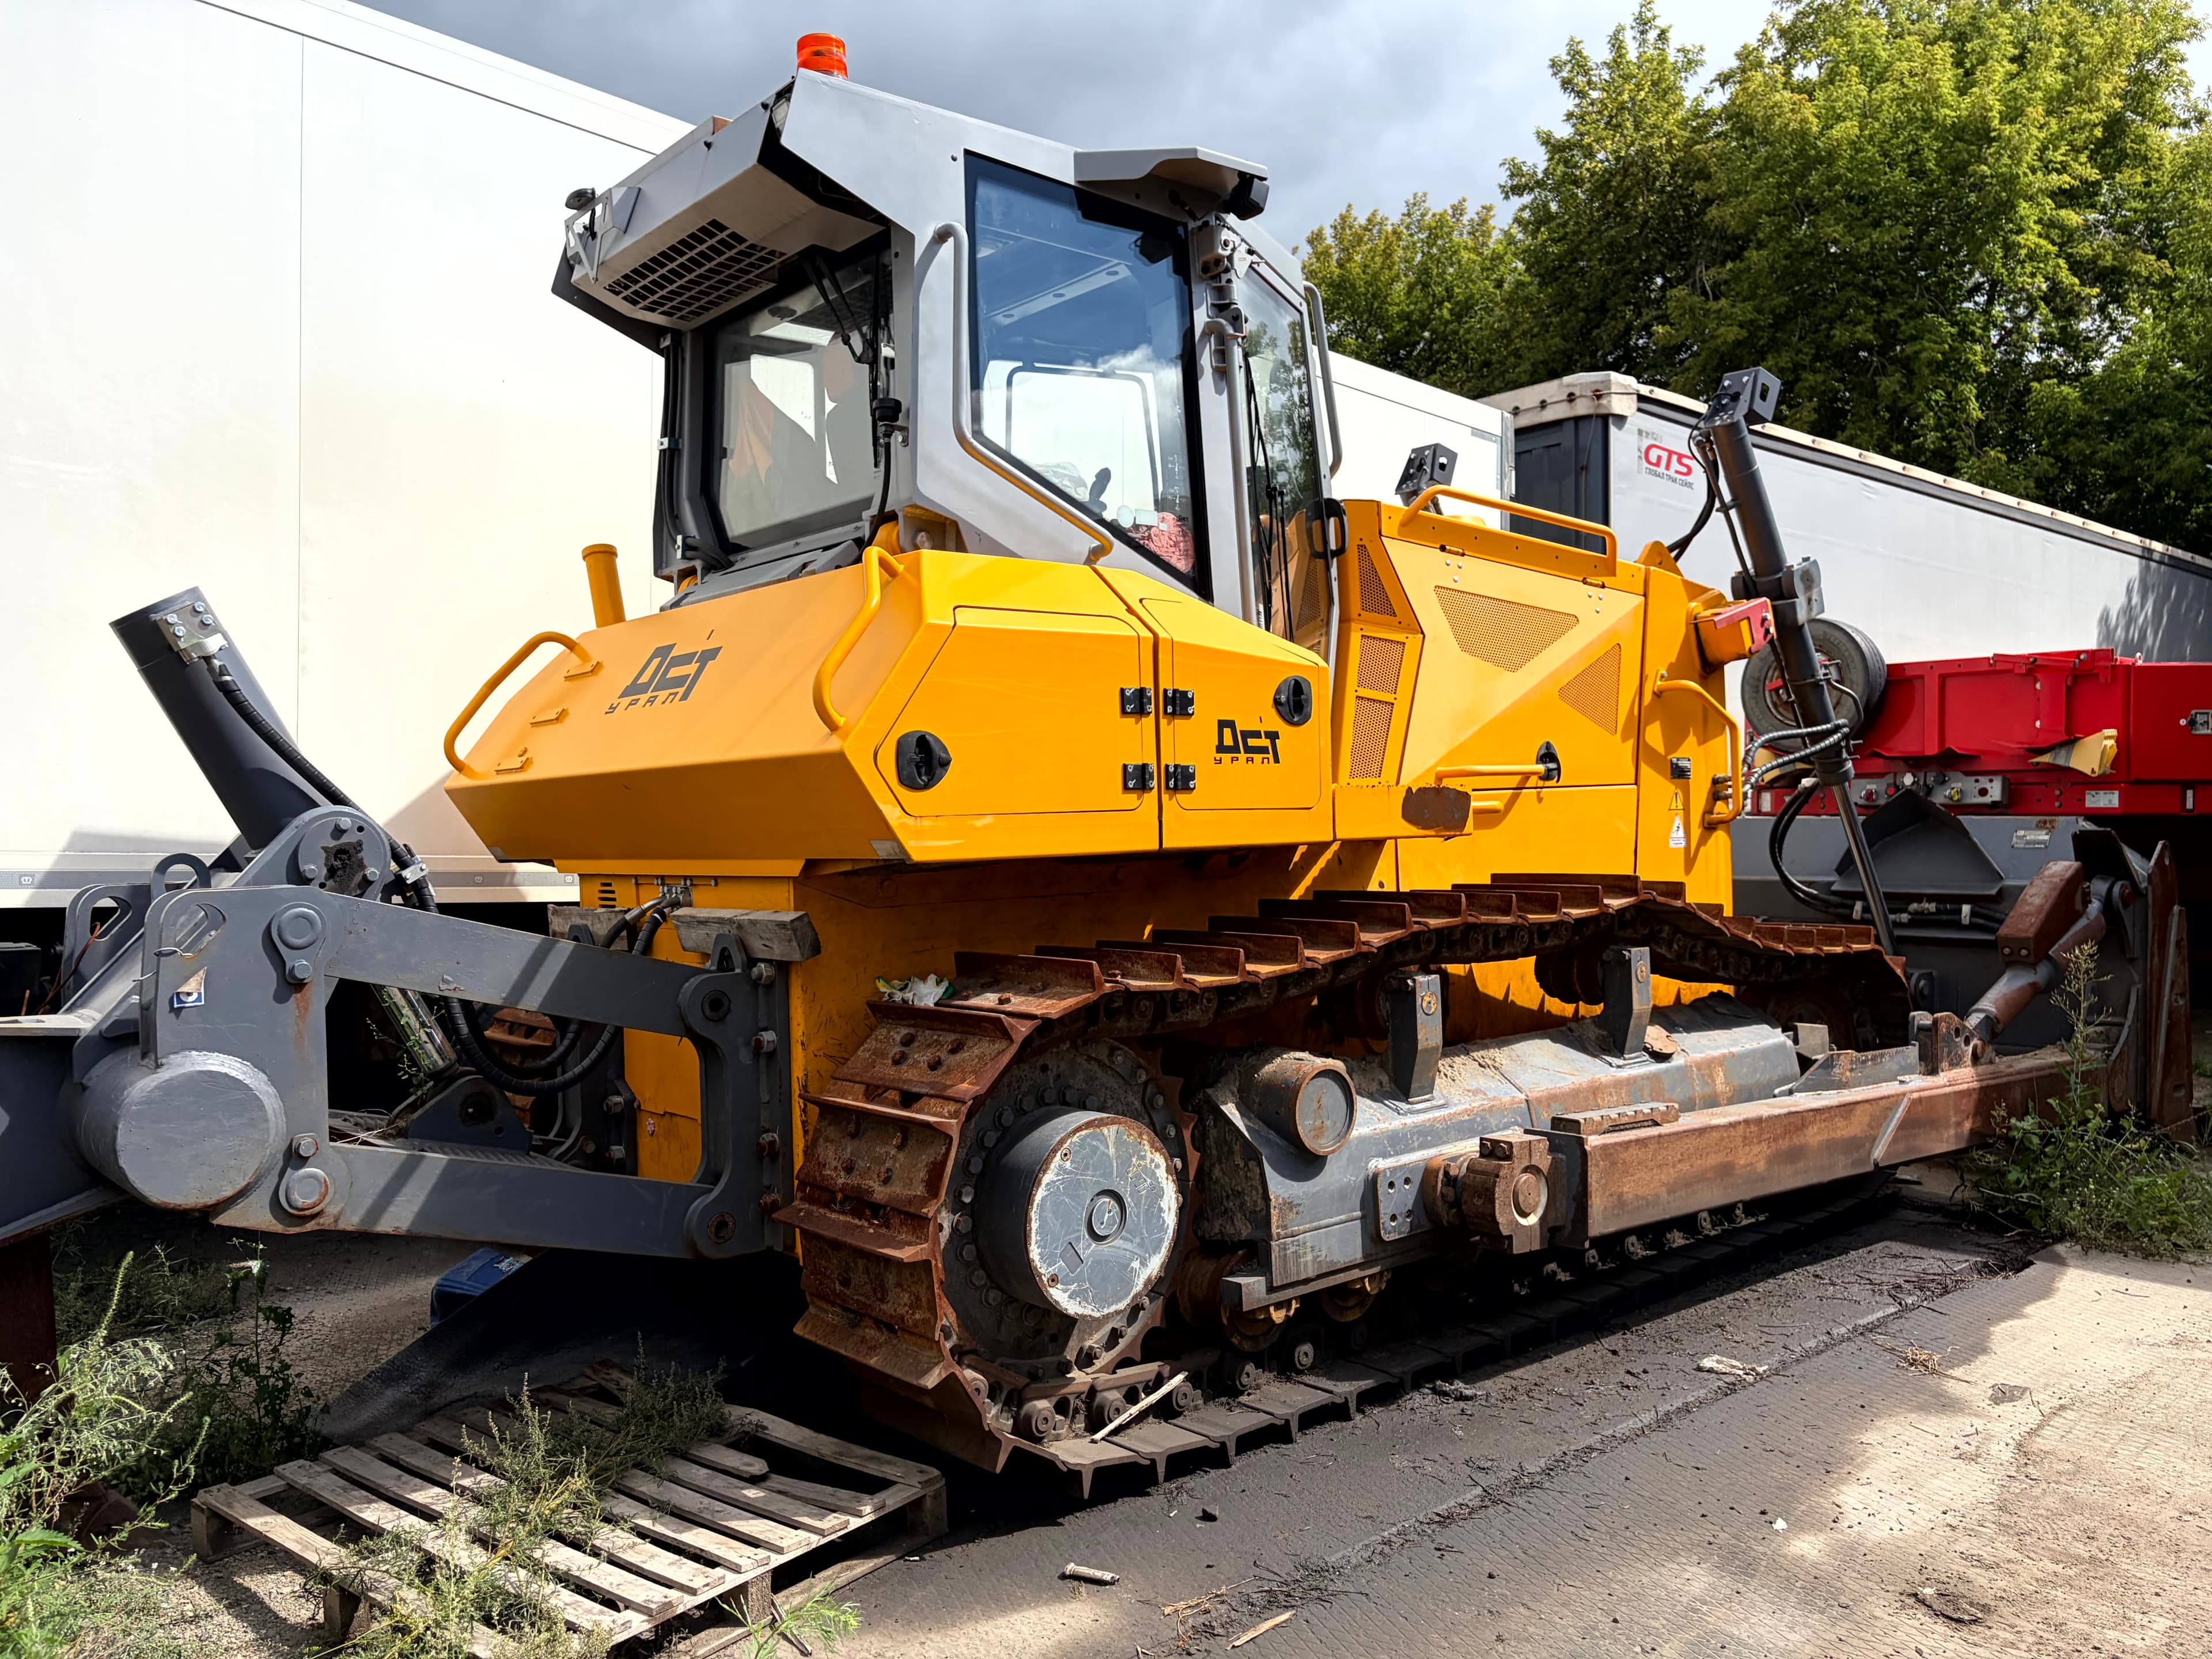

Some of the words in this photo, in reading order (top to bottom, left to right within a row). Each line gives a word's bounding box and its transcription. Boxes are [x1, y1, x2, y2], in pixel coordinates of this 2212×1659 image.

[1644, 443, 1694, 476] GTS
[1645, 467, 1664, 480] ГЛОБАЛ
[1666, 473, 1677, 484] ТРАК
[618, 642, 723, 702] ДСТ
[605, 691, 680, 715] УРАЛ
[1215, 719, 1280, 764] ДСТ
[1214, 756, 1270, 764] УРАЛ
